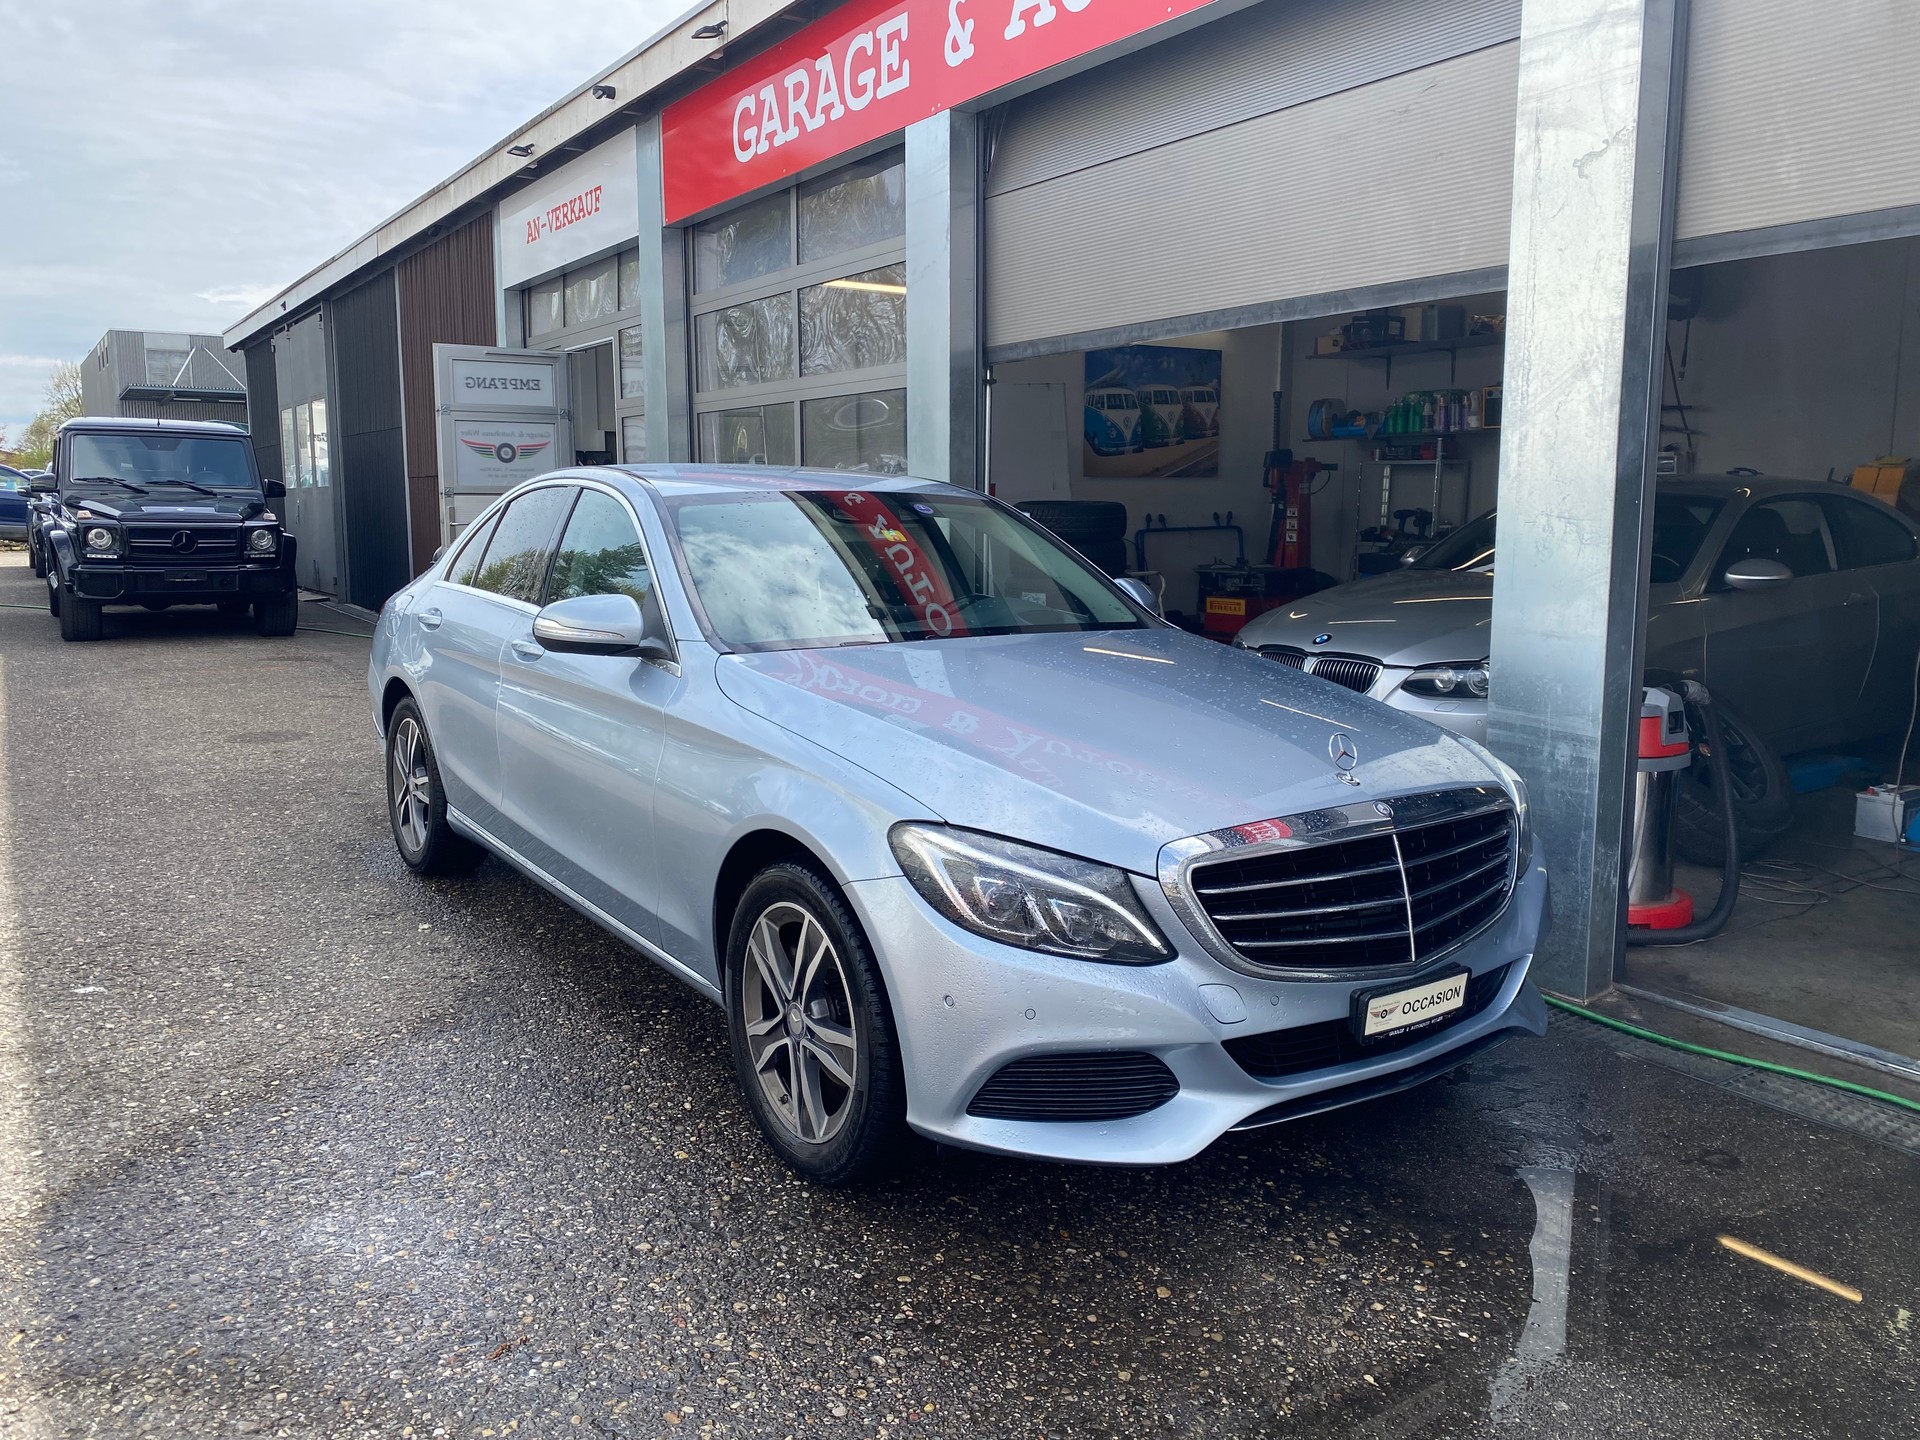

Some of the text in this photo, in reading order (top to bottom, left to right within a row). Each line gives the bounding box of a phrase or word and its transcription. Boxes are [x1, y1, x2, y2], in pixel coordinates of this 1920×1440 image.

[732, 0, 975, 164] GARAGE &
[526, 185, 602, 245] AN-VERKAUF
[1402, 985, 1461, 1015] OCCASION
